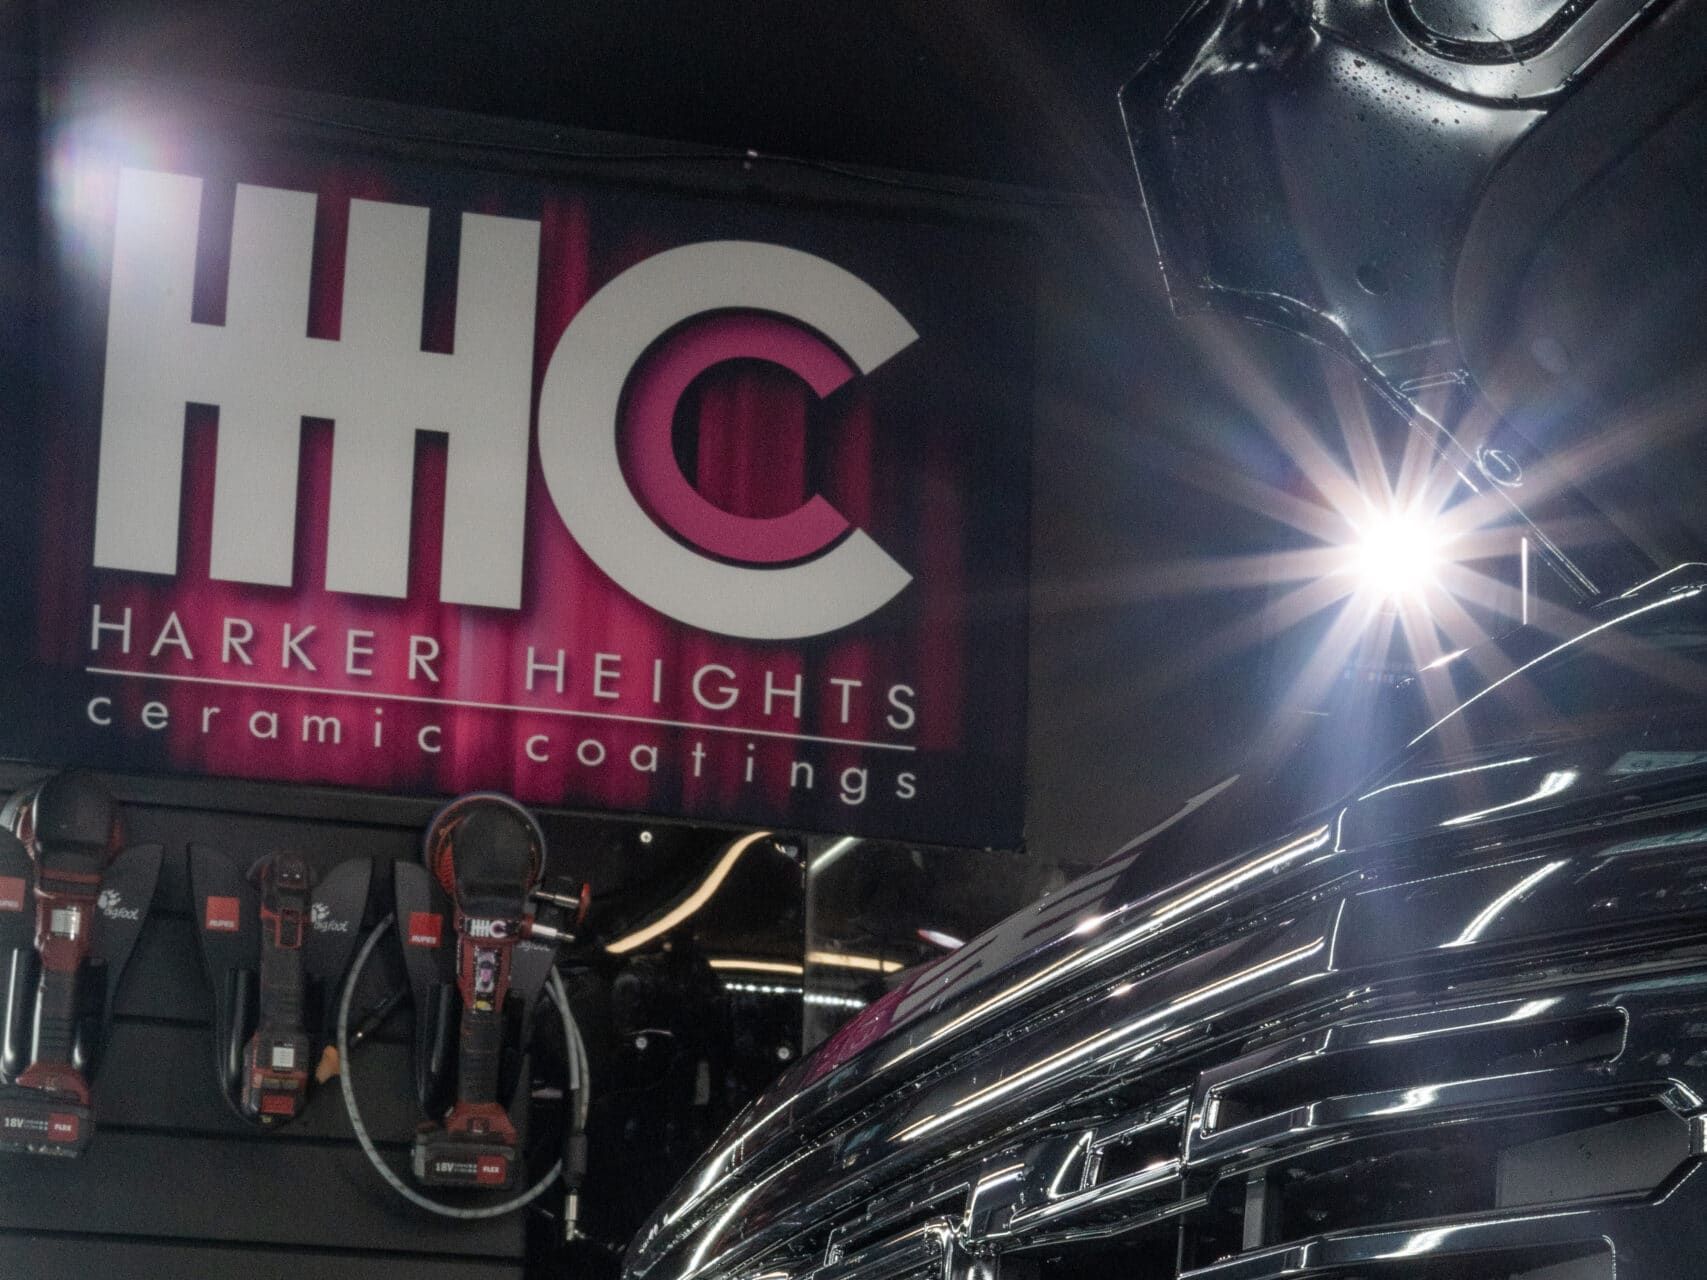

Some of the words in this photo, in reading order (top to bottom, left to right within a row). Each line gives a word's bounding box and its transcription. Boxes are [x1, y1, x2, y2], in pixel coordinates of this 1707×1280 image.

[91, 604, 440, 683] HARKER
[525, 645, 916, 731] HEIGHTS
[87, 697, 442, 754] ceramic
[525, 734, 916, 806] coatings
[4, 1116, 24, 1129] 18V
[54, 1123, 72, 1132] FLEX
[435, 1162, 454, 1173] 18V
[482, 1165, 500, 1174] FLEX
